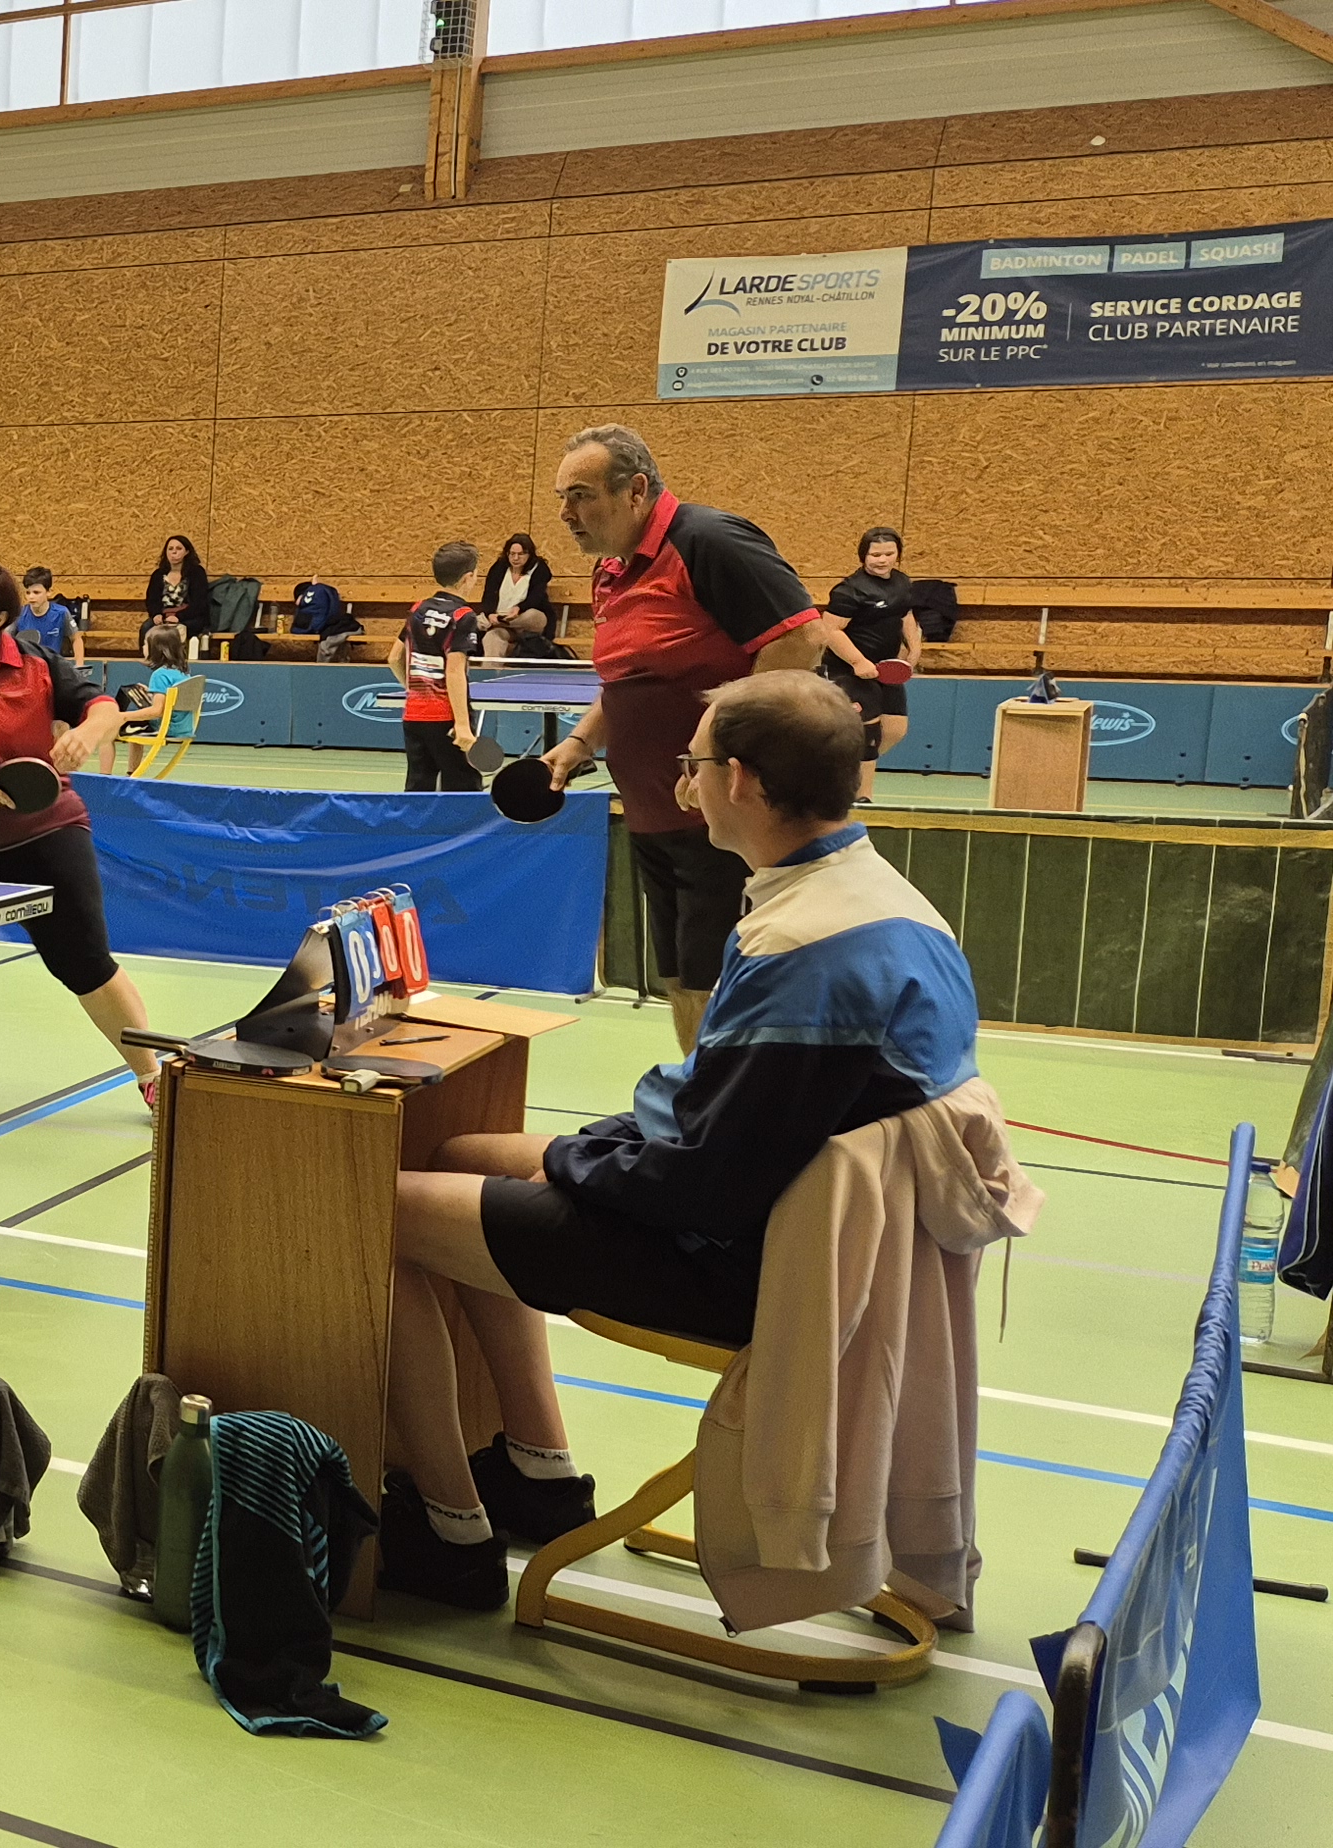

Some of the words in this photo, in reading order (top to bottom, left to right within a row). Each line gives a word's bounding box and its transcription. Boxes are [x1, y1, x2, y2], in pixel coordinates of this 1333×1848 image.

[989, 252, 1103, 271] BADMINTON
[1120, 251, 1179, 265] PADEL
[1199, 242, 1277, 262] SQUASH
[745, 296, 784, 306] RENNES
[941, 290, 1048, 323] -20%
[1089, 297, 1182, 318] SERVICE
[1187, 291, 1303, 313] CORDAGE
[707, 325, 766, 338] MAGASIN
[768, 322, 848, 335] PARTENAIRE
[940, 323, 1046, 342] MINIMUM
[1088, 321, 1149, 342] CLUB
[1155, 315, 1301, 338] PARTENAIRE
[706, 342, 731, 356] DE
[732, 339, 794, 355] VOTRE
[796, 336, 848, 352] CLUB
[937, 347, 976, 363] SUR
[980, 347, 1002, 361] LE
